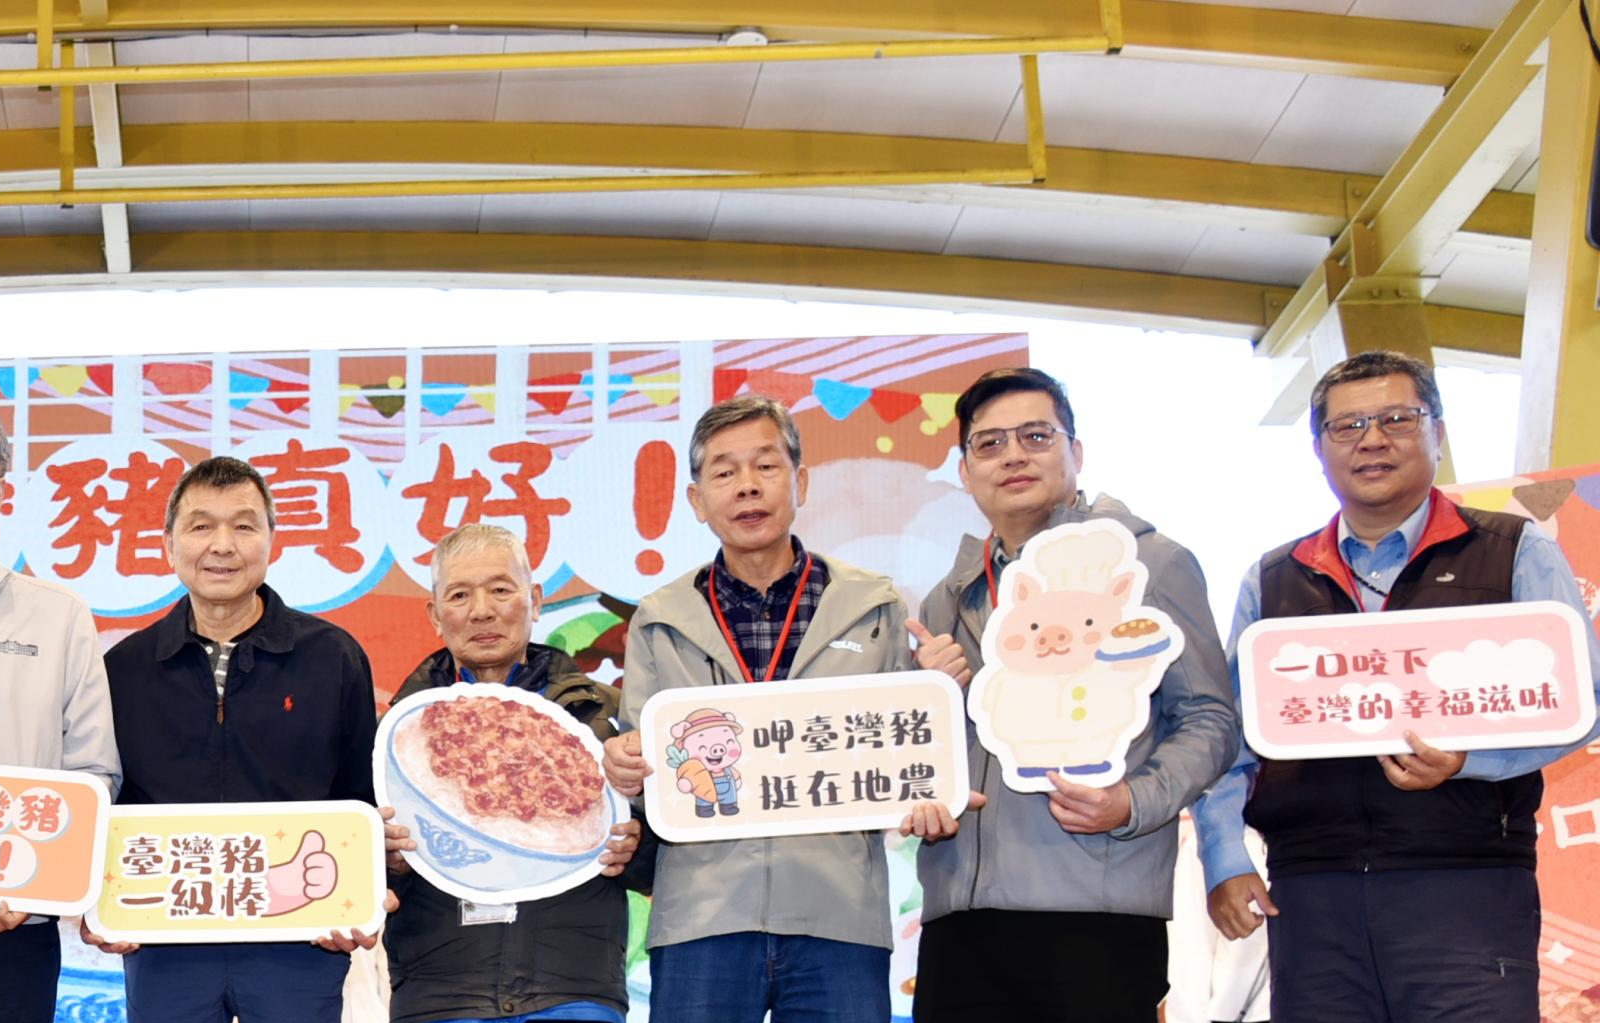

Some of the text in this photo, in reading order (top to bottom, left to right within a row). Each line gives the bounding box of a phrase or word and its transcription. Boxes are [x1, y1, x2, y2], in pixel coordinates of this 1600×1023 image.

[1273, 645, 1429, 678] 一口咬下
[1276, 682, 1560, 727] 臺灣的幸福滋味
[752, 713, 934, 756] 呷臺灣豬
[758, 765, 938, 812] 挺在地農
[121, 833, 267, 877] 臺灣豬
[120, 878, 267, 919] 一級棒
